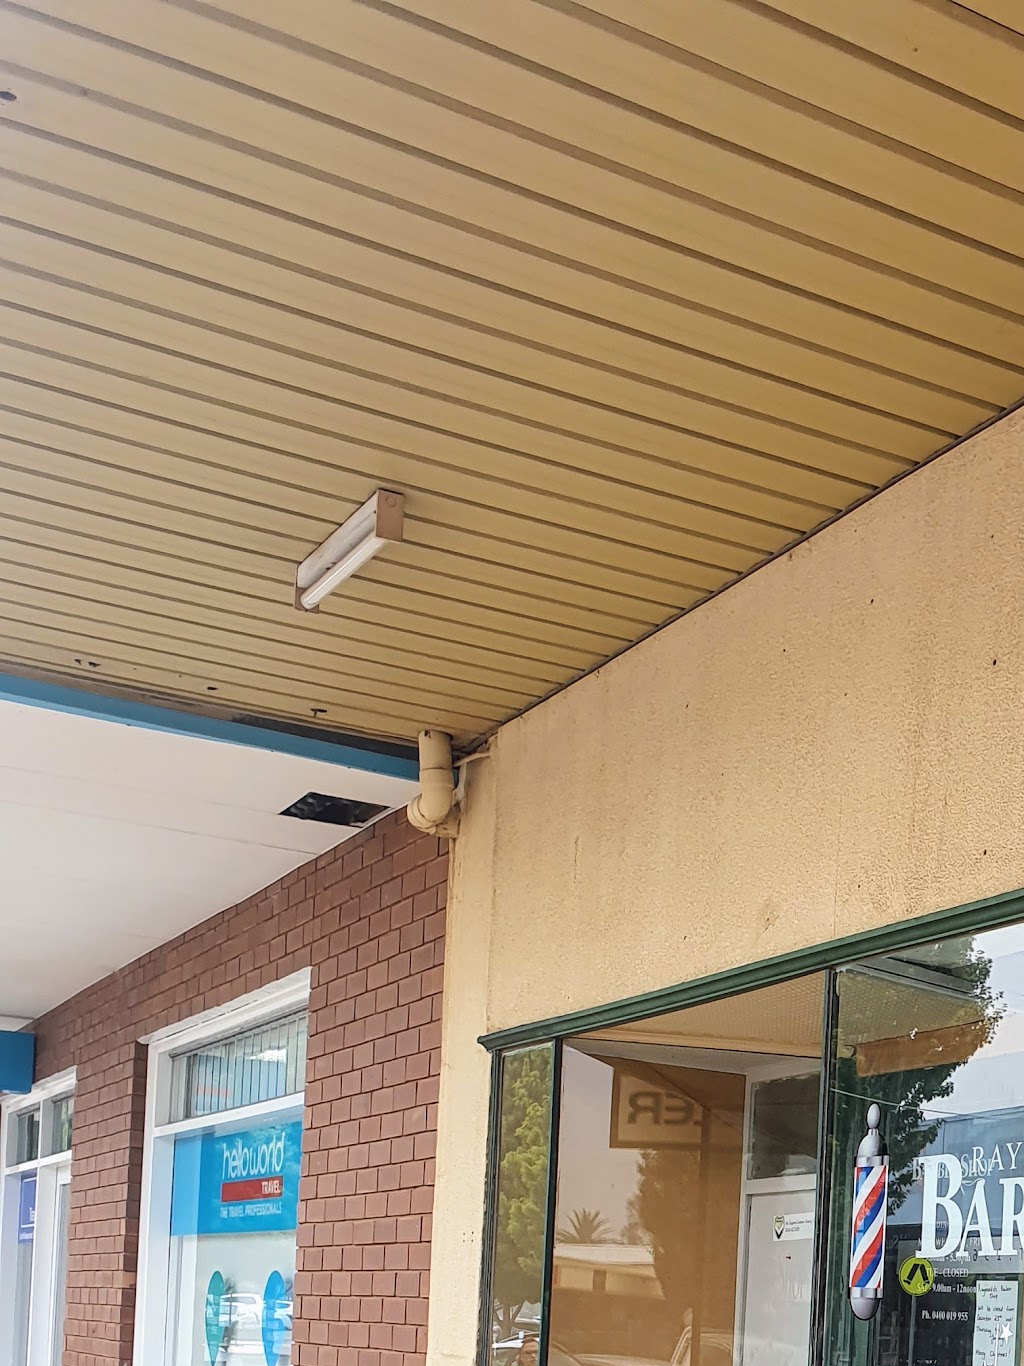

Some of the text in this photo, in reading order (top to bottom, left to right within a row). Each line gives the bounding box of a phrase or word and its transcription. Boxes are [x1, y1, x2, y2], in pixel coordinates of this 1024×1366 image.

[222, 1131, 285, 1179] helloworld
[261, 1180, 281, 1195] TRAVEL
[220, 1206, 228, 1218] THE
[943, 1268, 969, 1278] CLOSED
[931, 1310, 945, 1320] 0400
[946, 1311, 957, 1320] 019
[957, 1311, 969, 1321] 955
